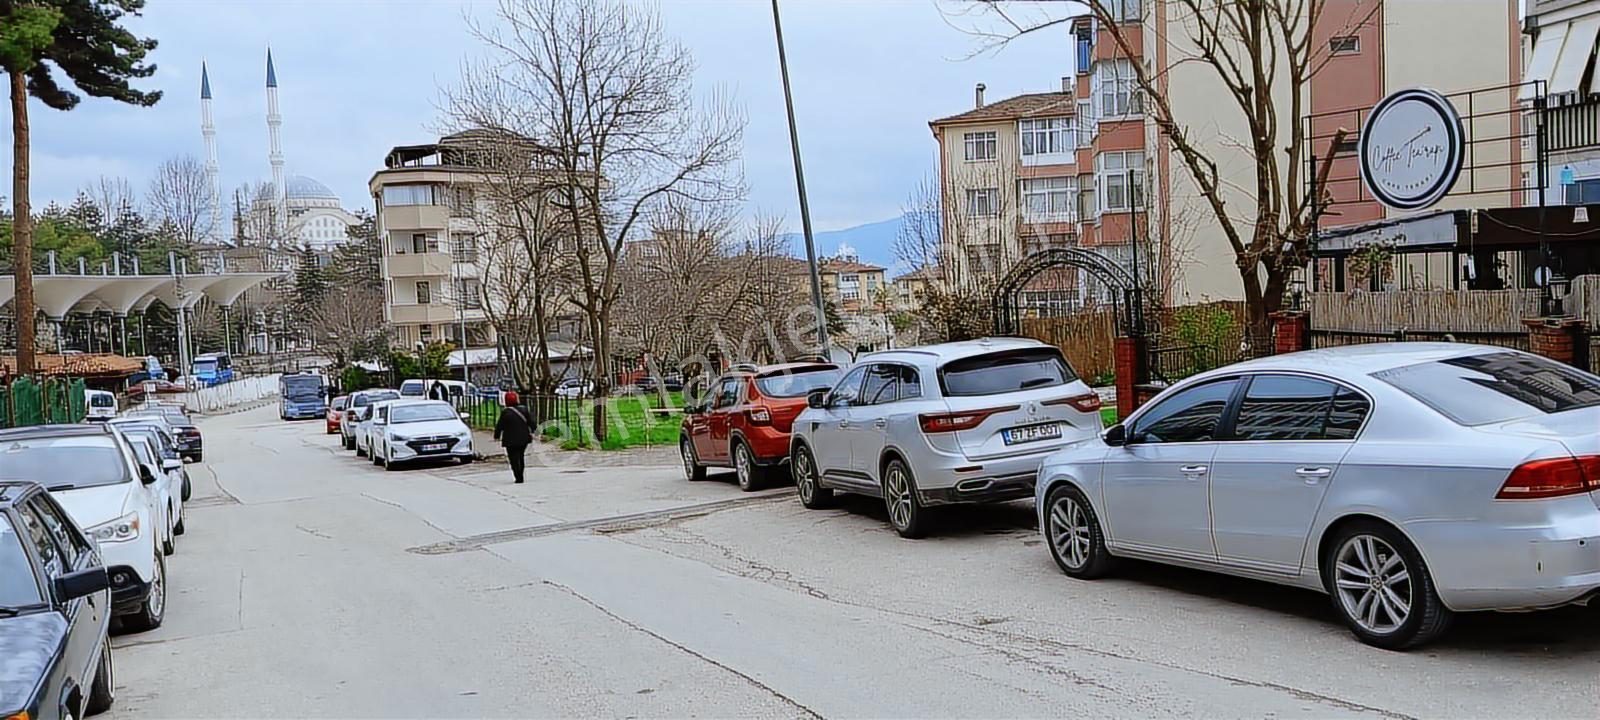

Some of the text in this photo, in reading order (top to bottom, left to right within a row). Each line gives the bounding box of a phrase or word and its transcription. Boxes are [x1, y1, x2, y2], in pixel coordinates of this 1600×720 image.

[1373, 145, 1401, 172] Coffee
[1011, 430, 1022, 440] 67
[1024, 427, 1037, 437] ZF
